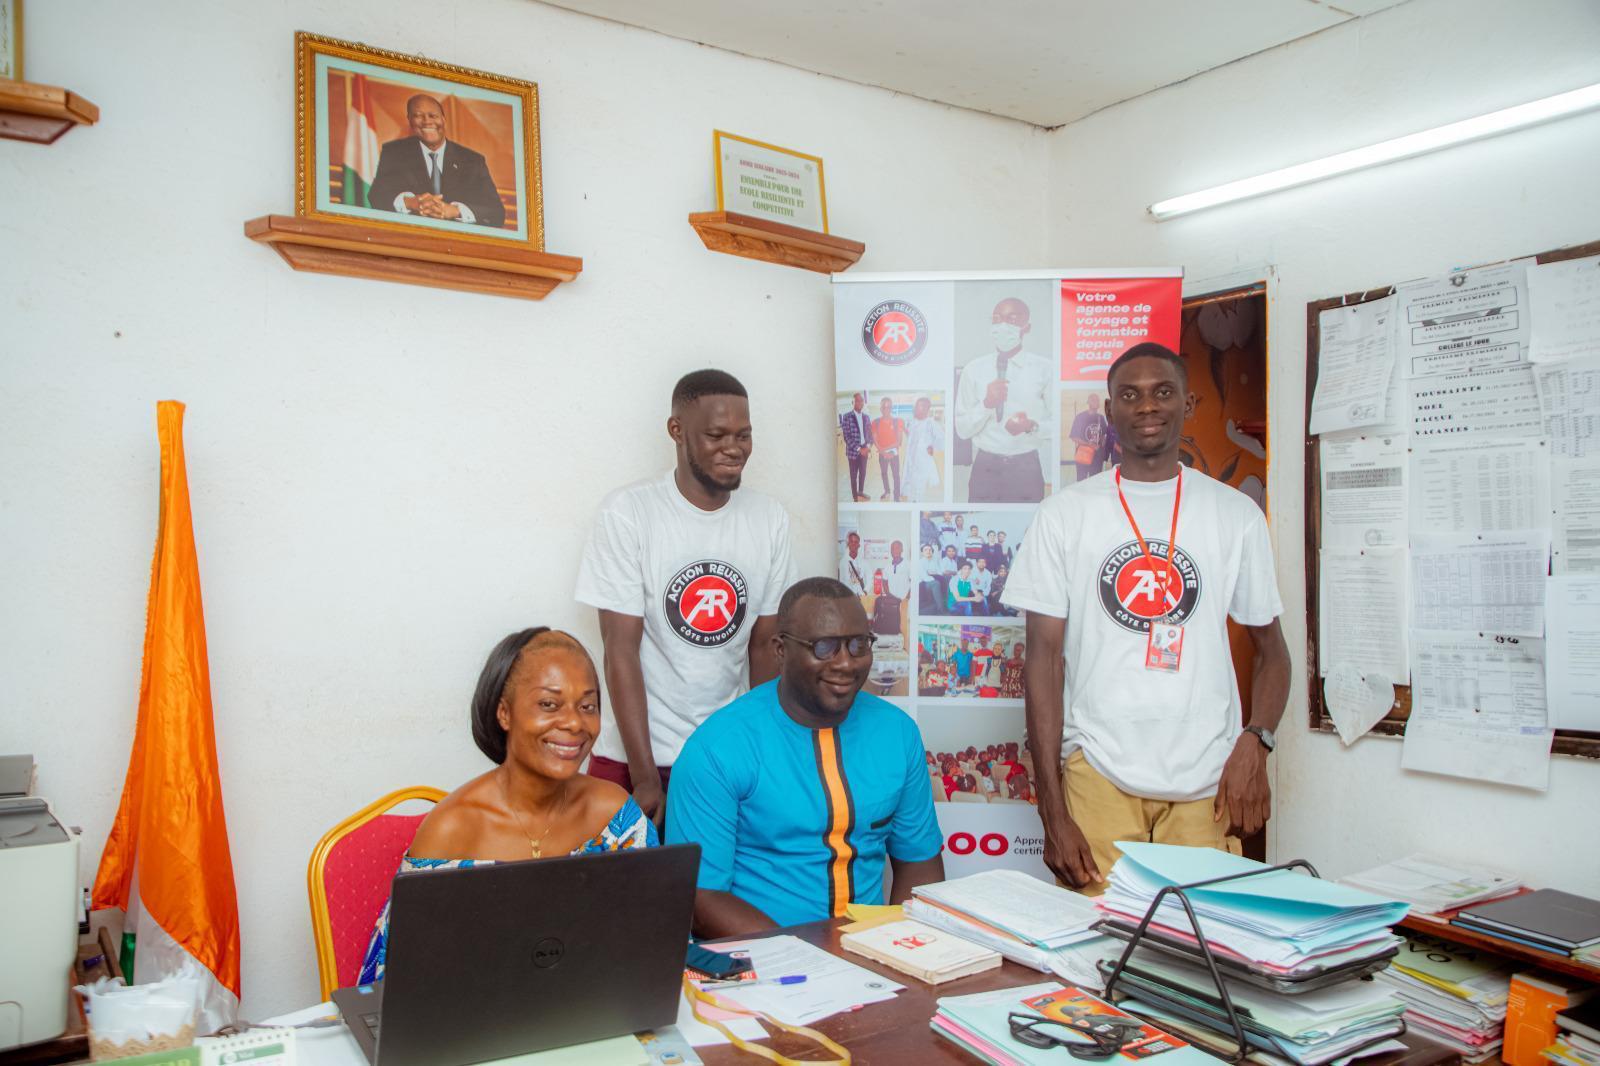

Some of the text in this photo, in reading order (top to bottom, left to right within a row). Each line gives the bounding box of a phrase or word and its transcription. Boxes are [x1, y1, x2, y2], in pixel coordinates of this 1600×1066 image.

[740, 175, 771, 190] ENSEMBLE
[1076, 292, 1116, 302] Votre
[1076, 303, 1152, 316] agence de
[865, 304, 890, 333] ACTION
[1076, 315, 1149, 327] voyage et
[1076, 326, 1148, 336] formation
[1076, 338, 1124, 350] depuis
[1102, 544, 1142, 585] ACTION
[668, 563, 747, 605] ACTION REUSSITE
[703, 623, 737, 643] D'IVOIRE
[1014, 846, 1045, 856] certifi
